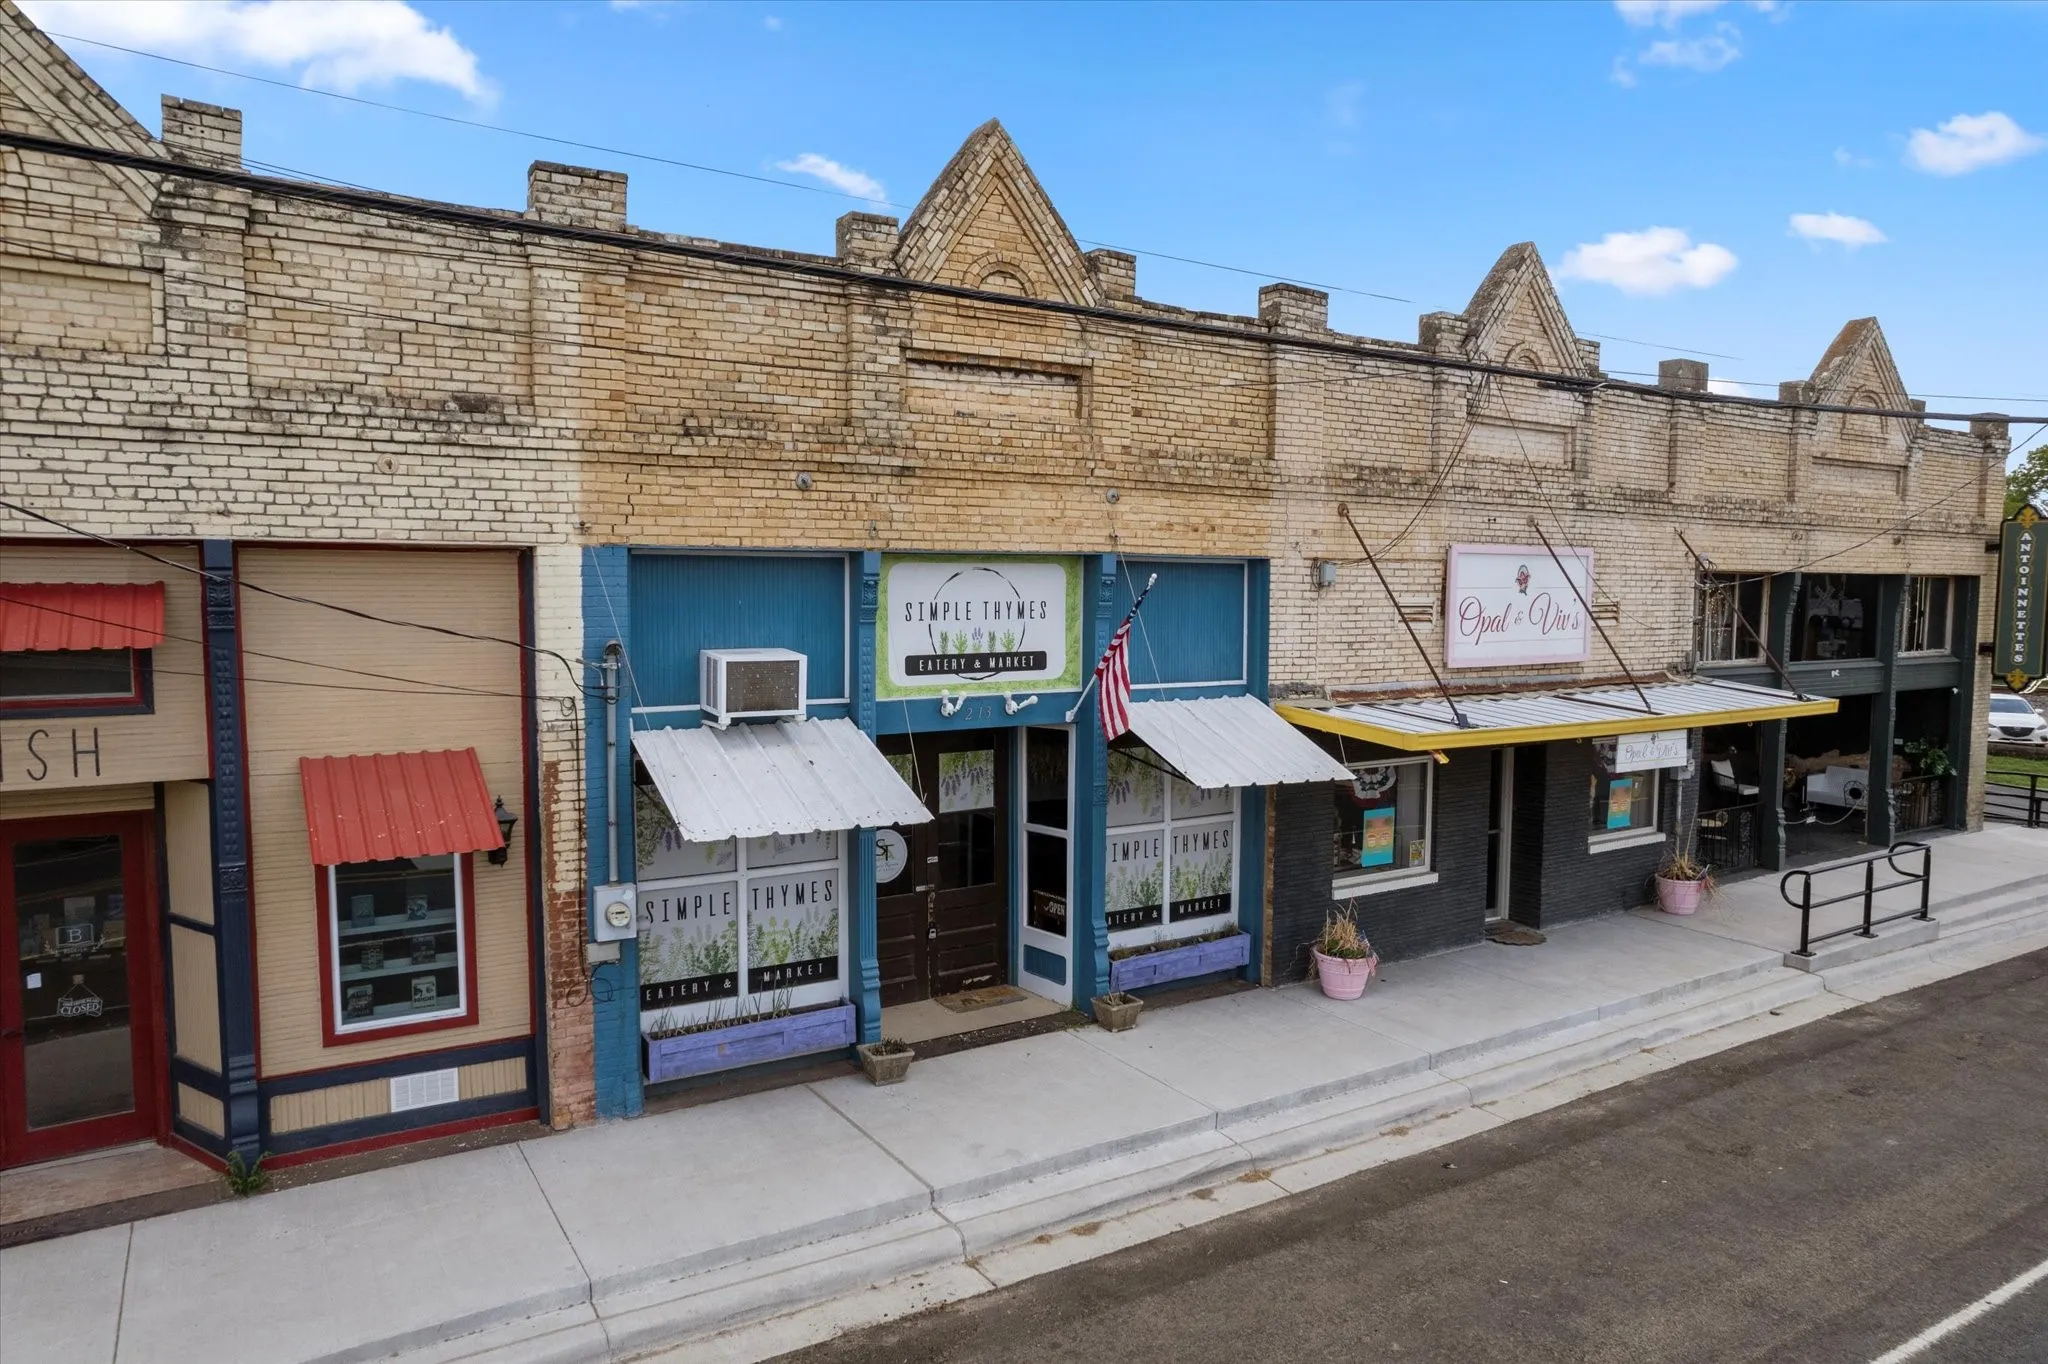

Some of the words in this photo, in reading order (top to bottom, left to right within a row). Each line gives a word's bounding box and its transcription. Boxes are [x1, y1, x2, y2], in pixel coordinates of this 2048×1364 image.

[905, 601, 972, 622] SIMPLE
[984, 600, 1047, 620] THYMES
[2013, 532, 2032, 663] ANTOINNETTES
[1459, 596, 1512, 646] Opal
[1514, 610, 1524, 625] &
[1528, 592, 1581, 635] Viv's
[919, 659, 966, 672] EATERY
[973, 659, 982, 669] &
[989, 655, 1035, 669] MARKET
[964, 706, 992, 721] 213
[1111, 838, 1159, 863] IMPLE
[1173, 829, 1229, 855] THYMES
[645, 891, 731, 924] SIMPLE
[752, 879, 832, 911] THYMES
[1107, 911, 1144, 926] ATERY
[1152, 910, 1158, 919] &
[1179, 898, 1221, 914] MARKET
[646, 982, 710, 1001] EATERY
[723, 978, 732, 989] &
[763, 963, 824, 983] MARKET
[61, 1002, 99, 1016] CLOSED
